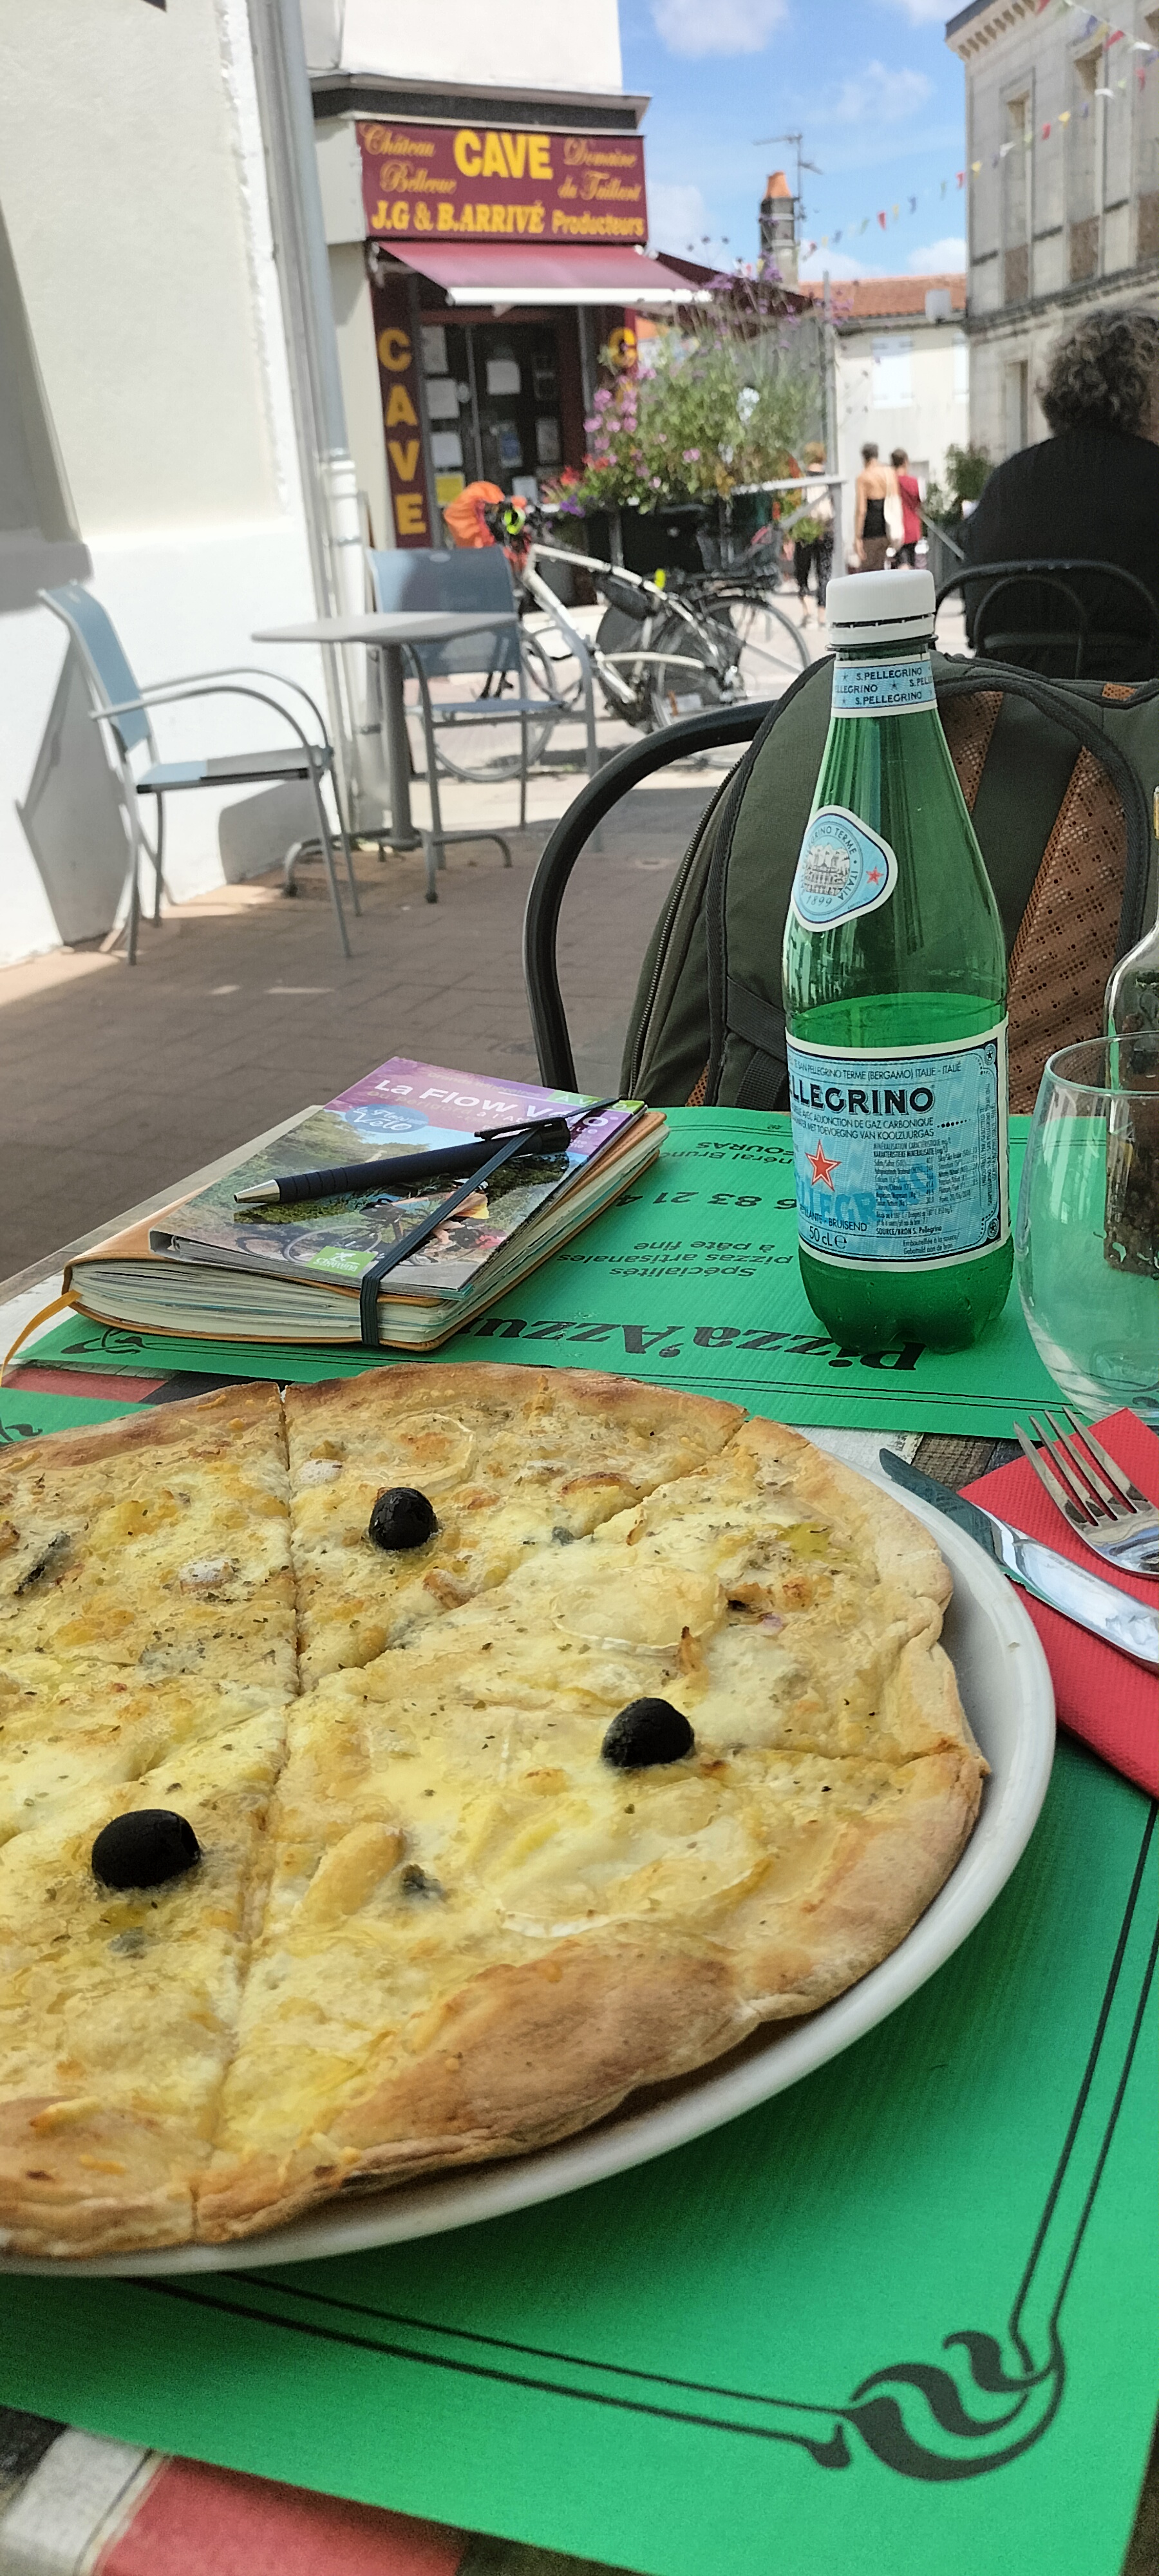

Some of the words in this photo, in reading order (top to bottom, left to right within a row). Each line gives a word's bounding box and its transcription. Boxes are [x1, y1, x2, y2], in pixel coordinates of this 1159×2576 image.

[454, 129, 553, 180] CAVE
[372, 200, 410, 231] J.G
[414, 201, 434, 231] &
[437, 200, 545, 234] B.ARRIVÉ
[552, 209, 644, 236] Producteurs
[377, 327, 427, 535] CAVE
[834, 828, 858, 855] TERME
[838, 871, 858, 900] ITALIA
[806, 895, 833, 907] 1899
[843, 1070, 867, 1080] TERME
[868, 1069, 914, 1081] (BERGAMO)
[915, 1067, 936, 1077] ITALIE
[374, 1079, 413, 1095] La
[419, 1088, 519, 1113] Flow
[789, 1075, 936, 1116] LLEGRINO
[579, 1098, 628, 1110] VO
[814, 1113, 853, 1128] ADJONCTION
[854, 1120, 863, 1128] DE
[865, 1121, 881, 1129] GAZ
[883, 1117, 934, 1130] CARBONIQUE
[817, 1124, 858, 1139] TOEVOEGING
[860, 1131, 876, 1140] VAN
[878, 1129, 934, 1141] KOOLZUURGAS
[732, 1153, 793, 1164] néral
[616, 1195, 643, 1207] 4
[653, 1191, 699, 1204] 21
[707, 1193, 762, 1207] 83
[773, 1198, 797, 1209] 6
[828, 1217, 867, 1232] BRUISEND
[809, 1226, 820, 1242] 50
[822, 1235, 833, 1247] cL
[634, 1240, 683, 1251] fine
[690, 1240, 752, 1251] pâte
[759, 1243, 775, 1253] à
[556, 1253, 698, 1265] artisanales
[707, 1253, 794, 1265] pizzas
[608, 1266, 757, 1278] Spécialités
